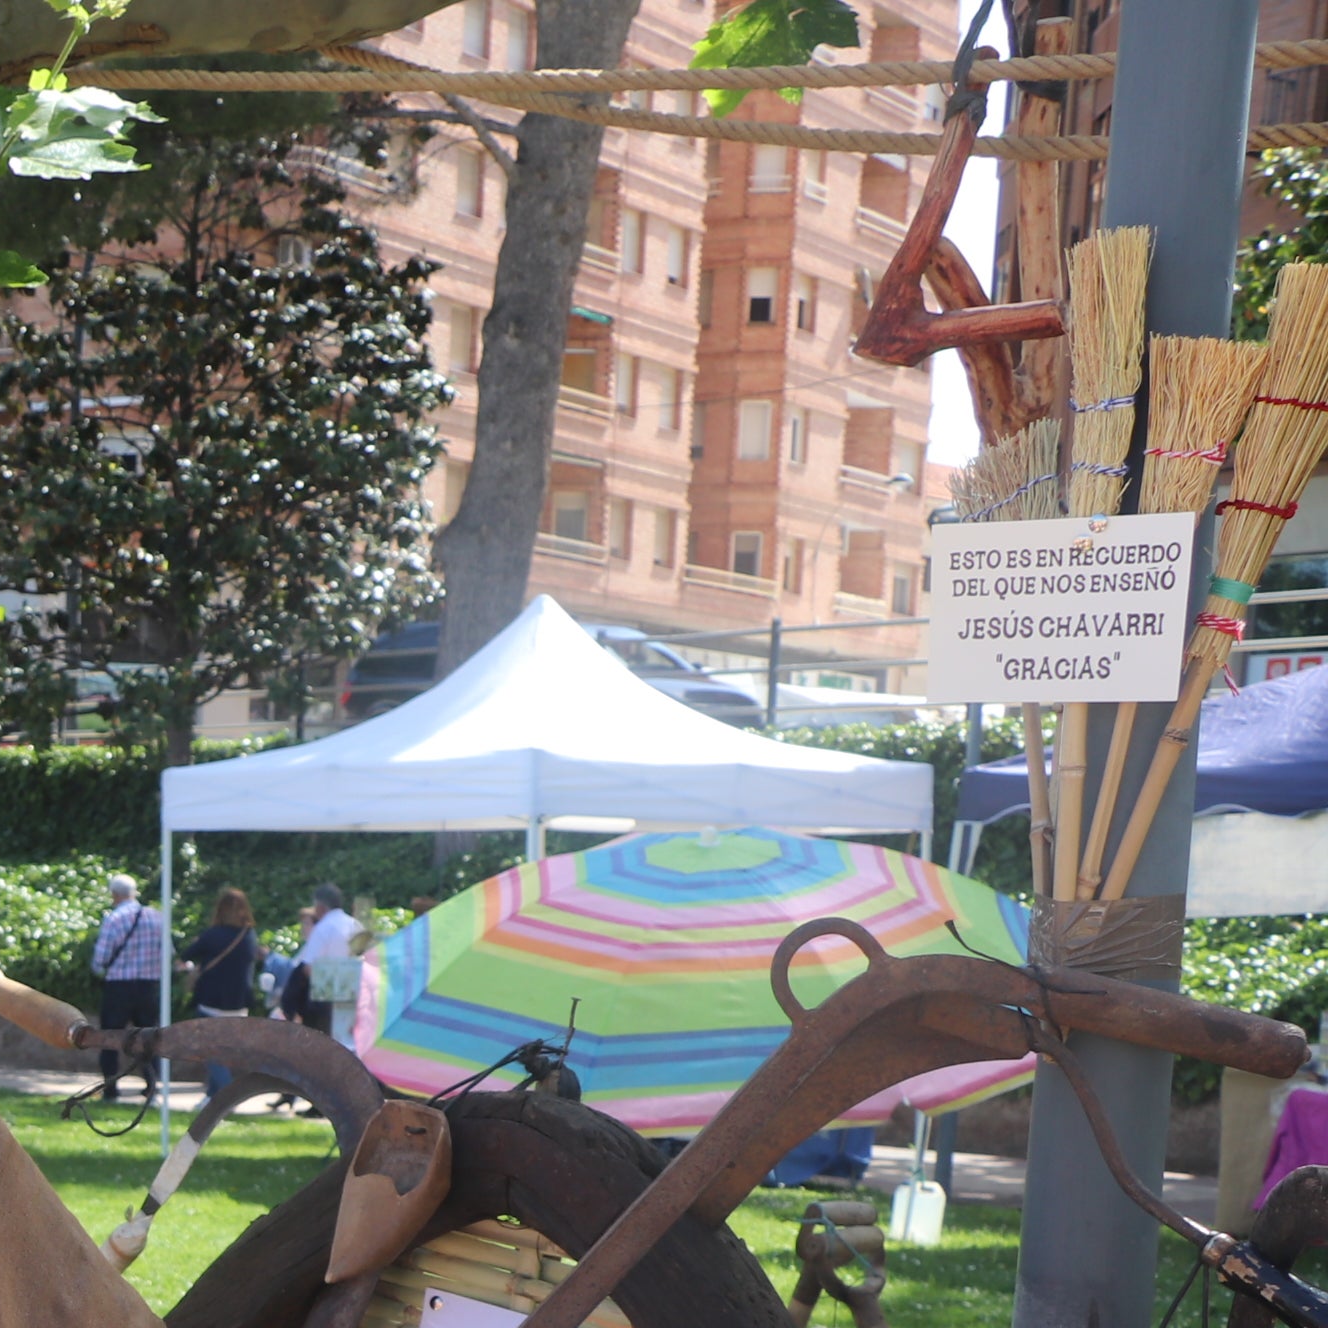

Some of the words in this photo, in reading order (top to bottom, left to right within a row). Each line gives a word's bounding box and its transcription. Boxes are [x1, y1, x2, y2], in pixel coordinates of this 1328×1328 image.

[949, 549, 1002, 570] ESTO
[1006, 548, 1032, 569] ES
[1035, 547, 1064, 568] EN
[1068, 542, 1182, 567] RECUERDO
[951, 578, 990, 598] DEL
[994, 577, 1037, 600] QUE
[1040, 573, 1086, 595] NOS
[1089, 564, 1176, 593] ENSEÑÓ
[957, 610, 1034, 640] JESÚS
[1038, 612, 1165, 638] CHAVARRI
[995, 651, 1121, 681] "GRACIAS"
